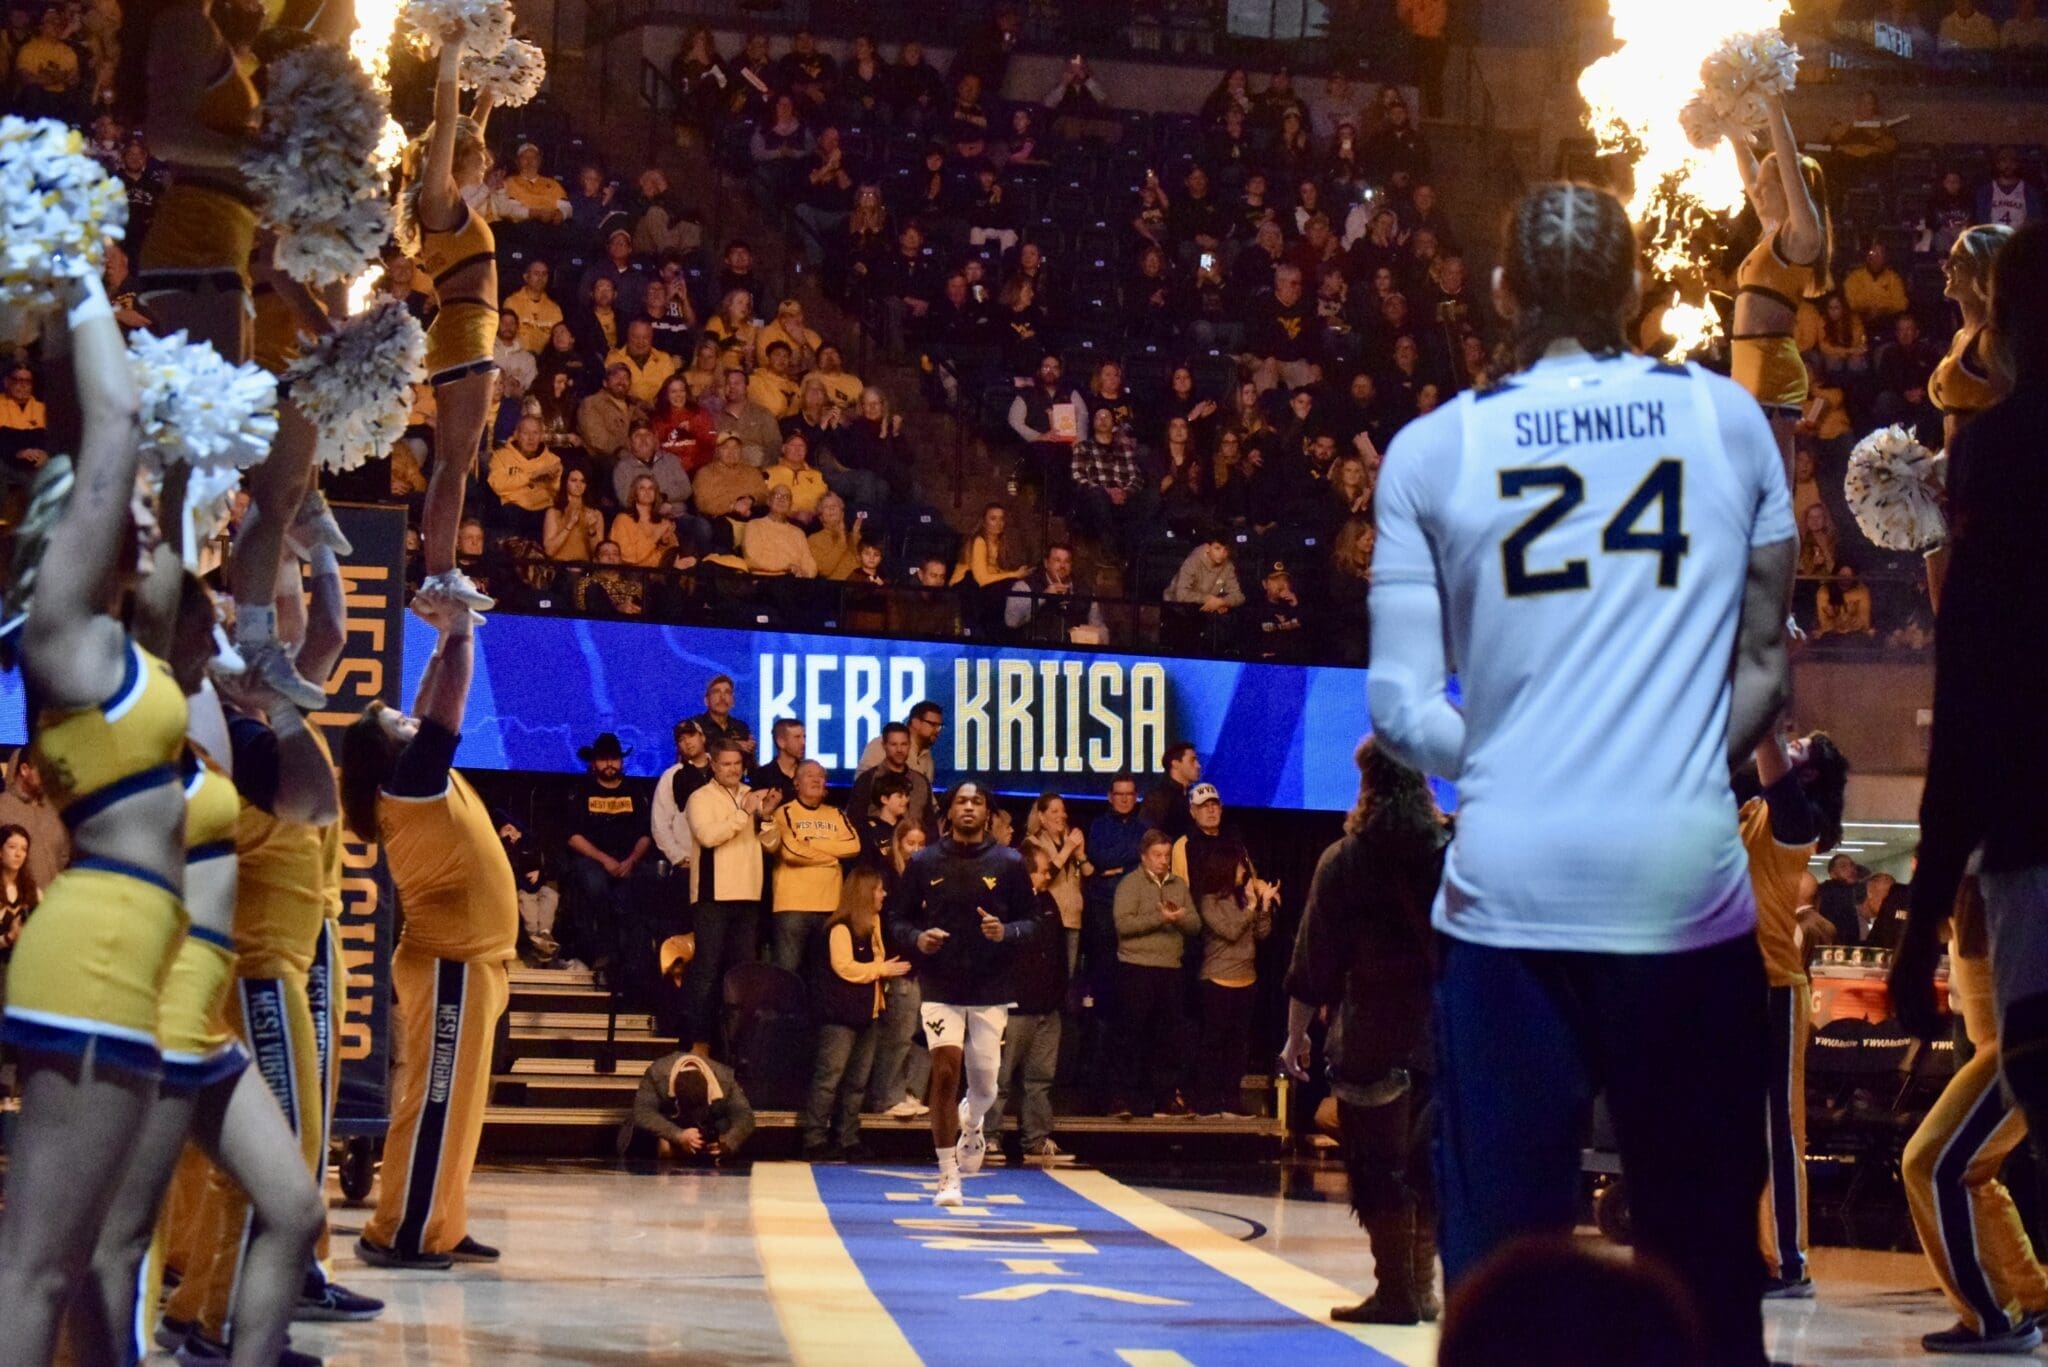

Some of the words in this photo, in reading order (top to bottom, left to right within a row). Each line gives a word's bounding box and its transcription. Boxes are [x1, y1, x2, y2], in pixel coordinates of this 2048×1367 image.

[1514, 400, 1667, 447] SUEMNICK
[1497, 456, 1691, 598] 24
[758, 653, 927, 769] KERR
[954, 657, 1166, 773] KRIISA
[250, 990, 282, 1041] WEST
[435, 1003, 459, 1040] WEST
[429, 1042, 455, 1104] VIRGINIA
